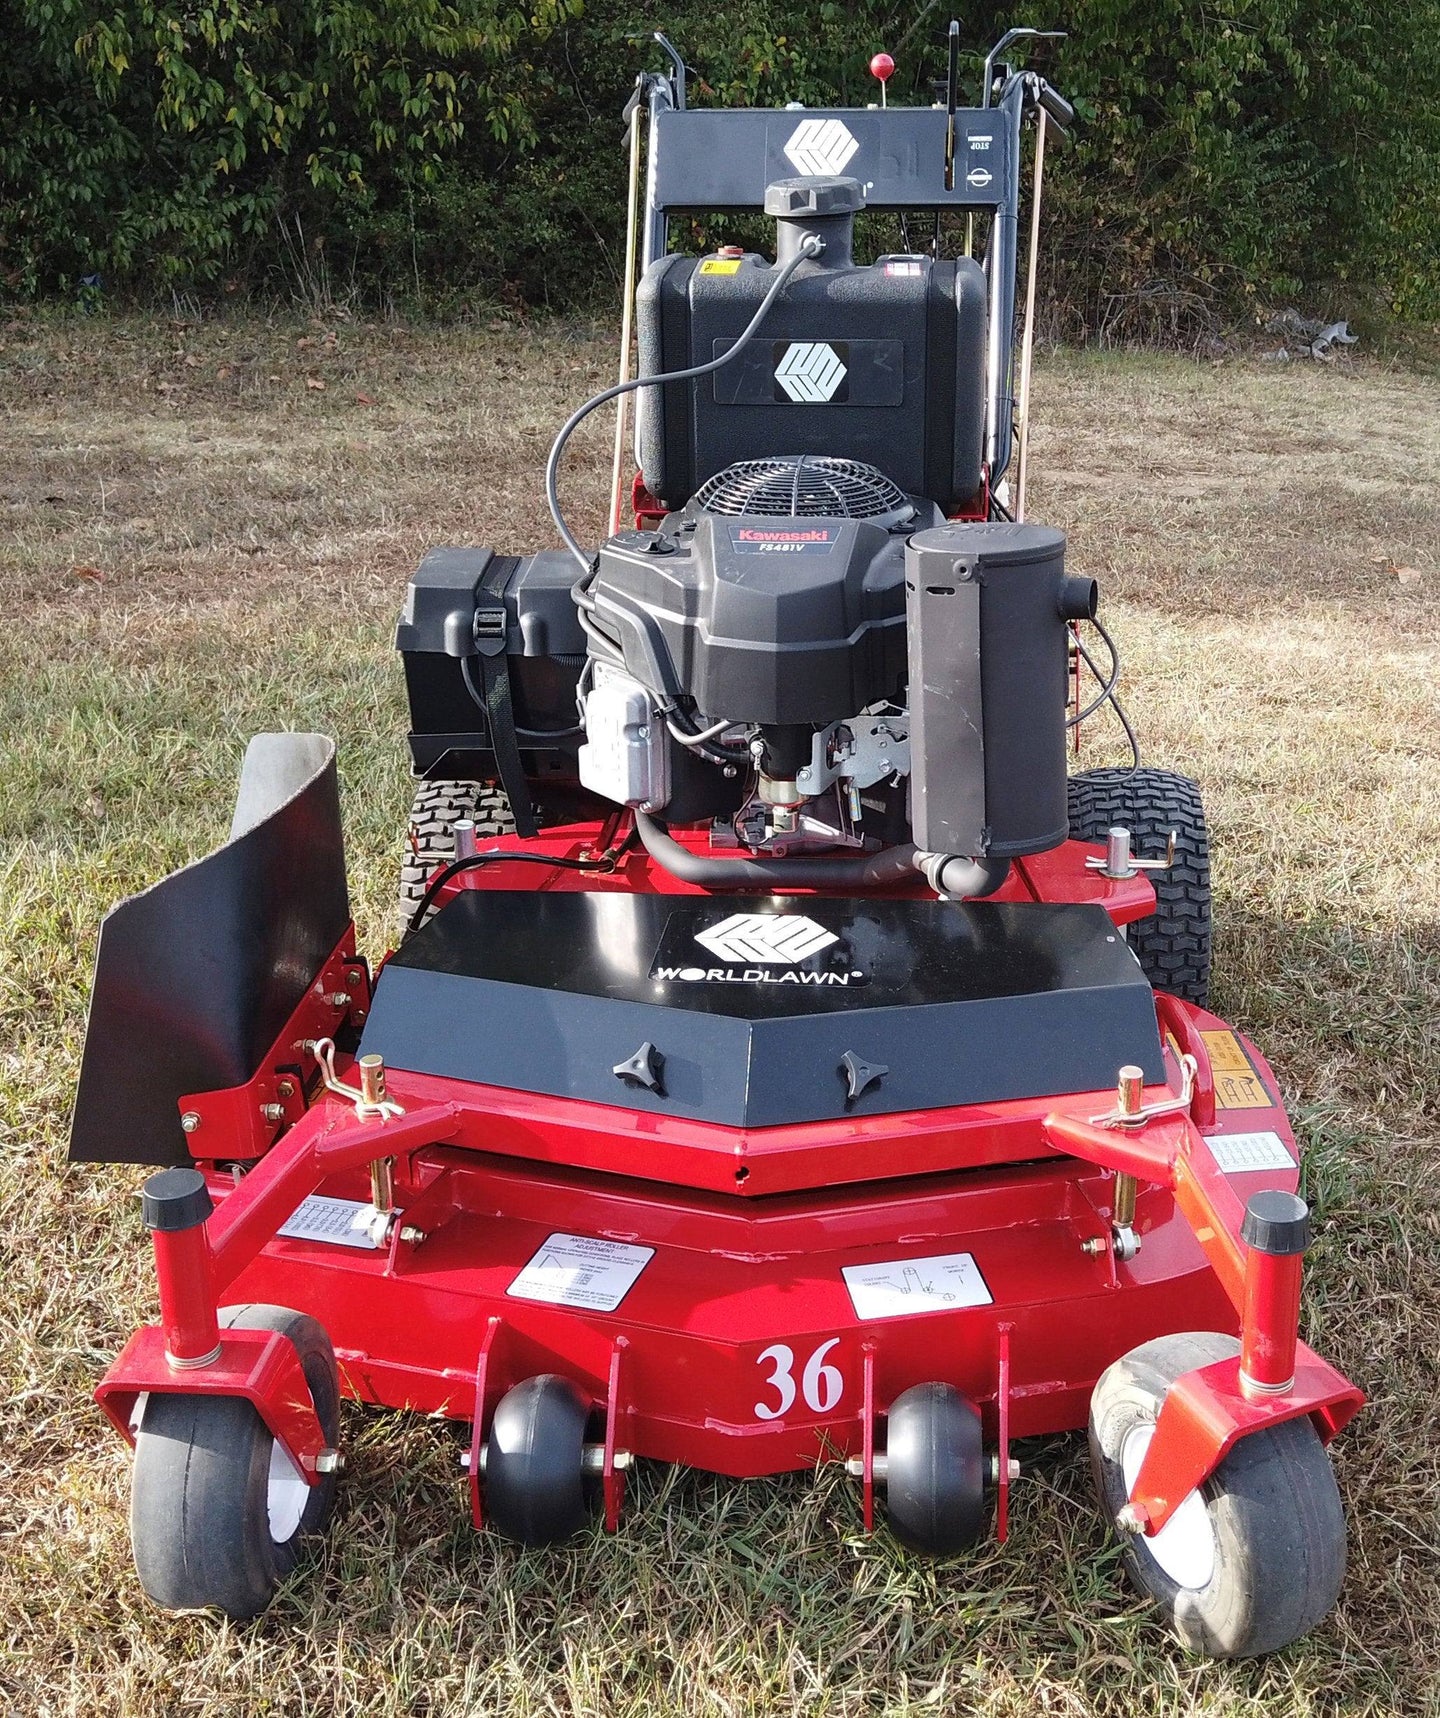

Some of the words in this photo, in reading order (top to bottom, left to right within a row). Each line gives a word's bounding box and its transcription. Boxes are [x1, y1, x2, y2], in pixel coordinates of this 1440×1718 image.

[970, 142, 990, 150] STOP
[739, 530, 828, 541] Kawasaki
[759, 543, 805, 551] FS481V
[754, 1337, 844, 1420] 36
